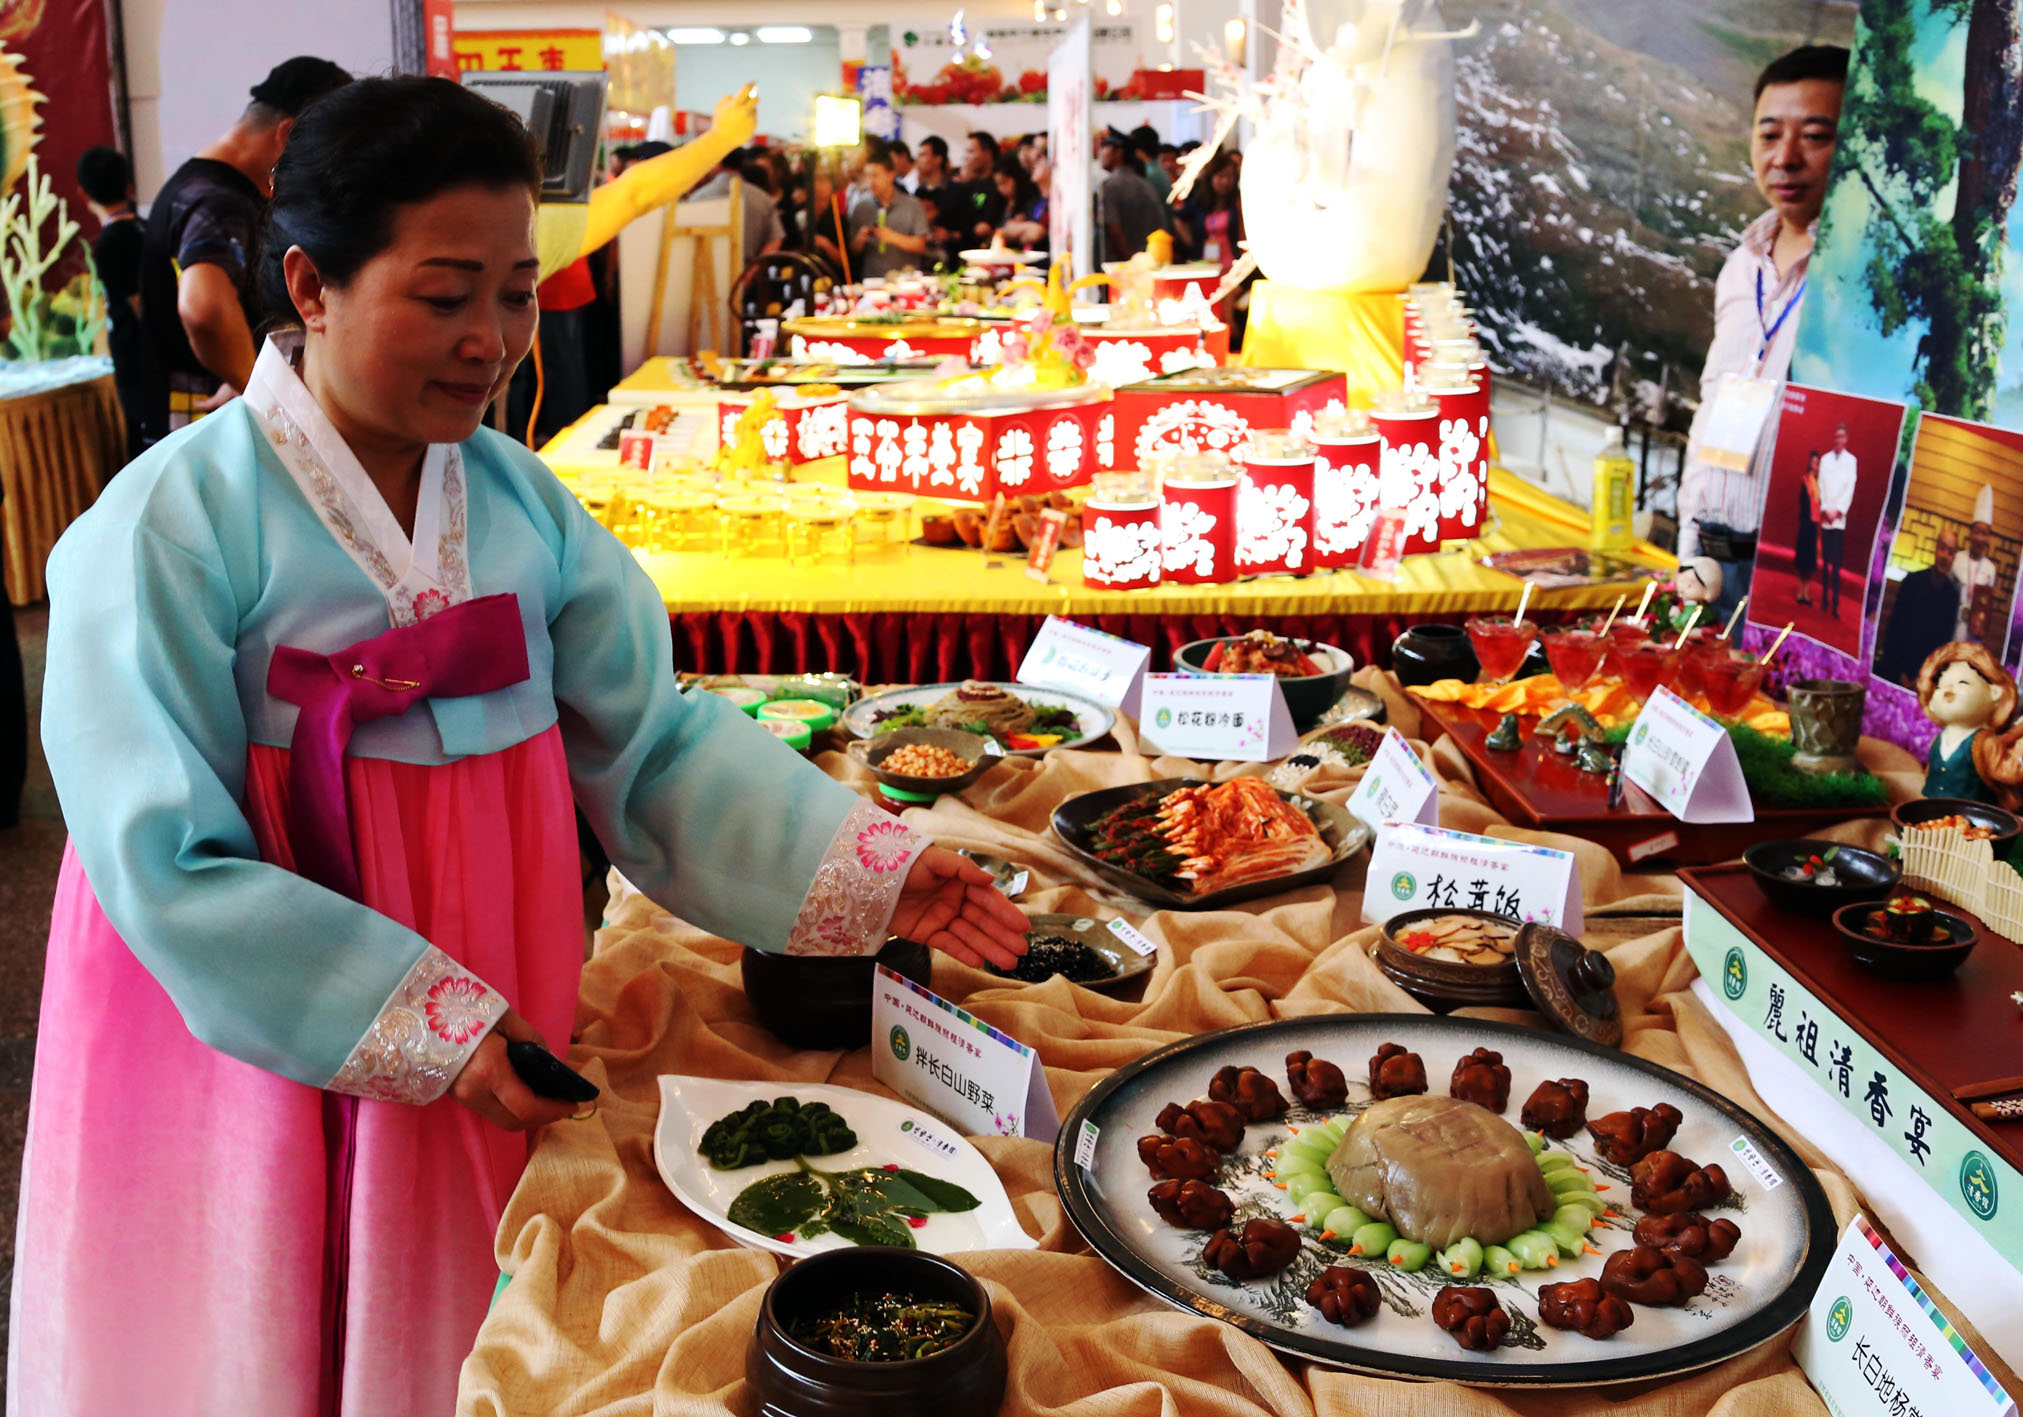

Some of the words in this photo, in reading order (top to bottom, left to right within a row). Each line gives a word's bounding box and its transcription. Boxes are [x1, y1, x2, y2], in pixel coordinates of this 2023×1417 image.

[1427, 873, 1523, 920] 松茸饭
[915, 1045, 995, 1116] 拌长白山野菜
